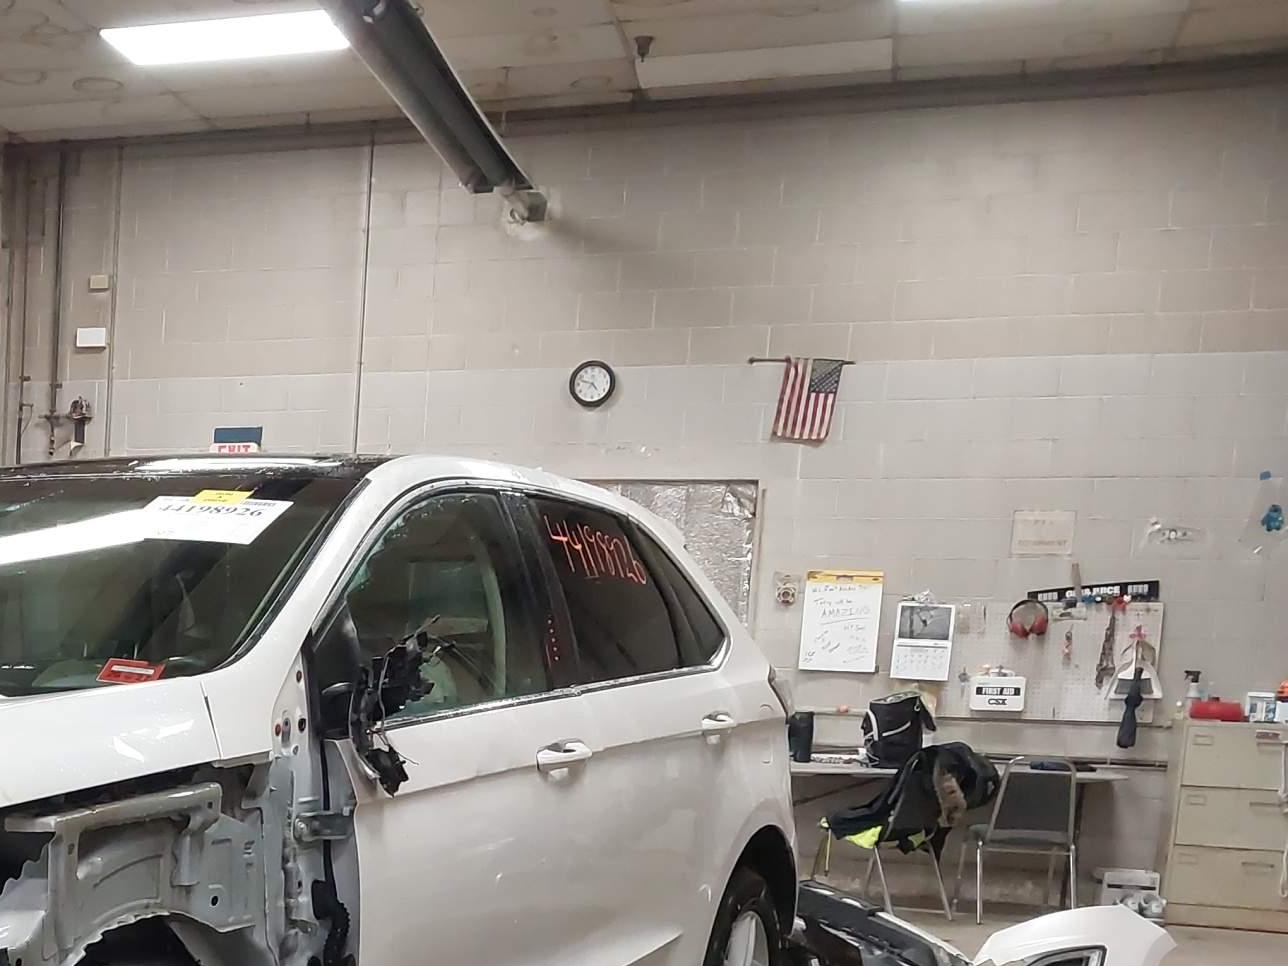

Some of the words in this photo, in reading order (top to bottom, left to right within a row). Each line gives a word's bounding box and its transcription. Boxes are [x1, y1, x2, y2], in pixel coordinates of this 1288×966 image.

[982, 687, 1001, 696] FIRST
[1001, 687, 1015, 696] AID
[987, 698, 1008, 706] CSX
